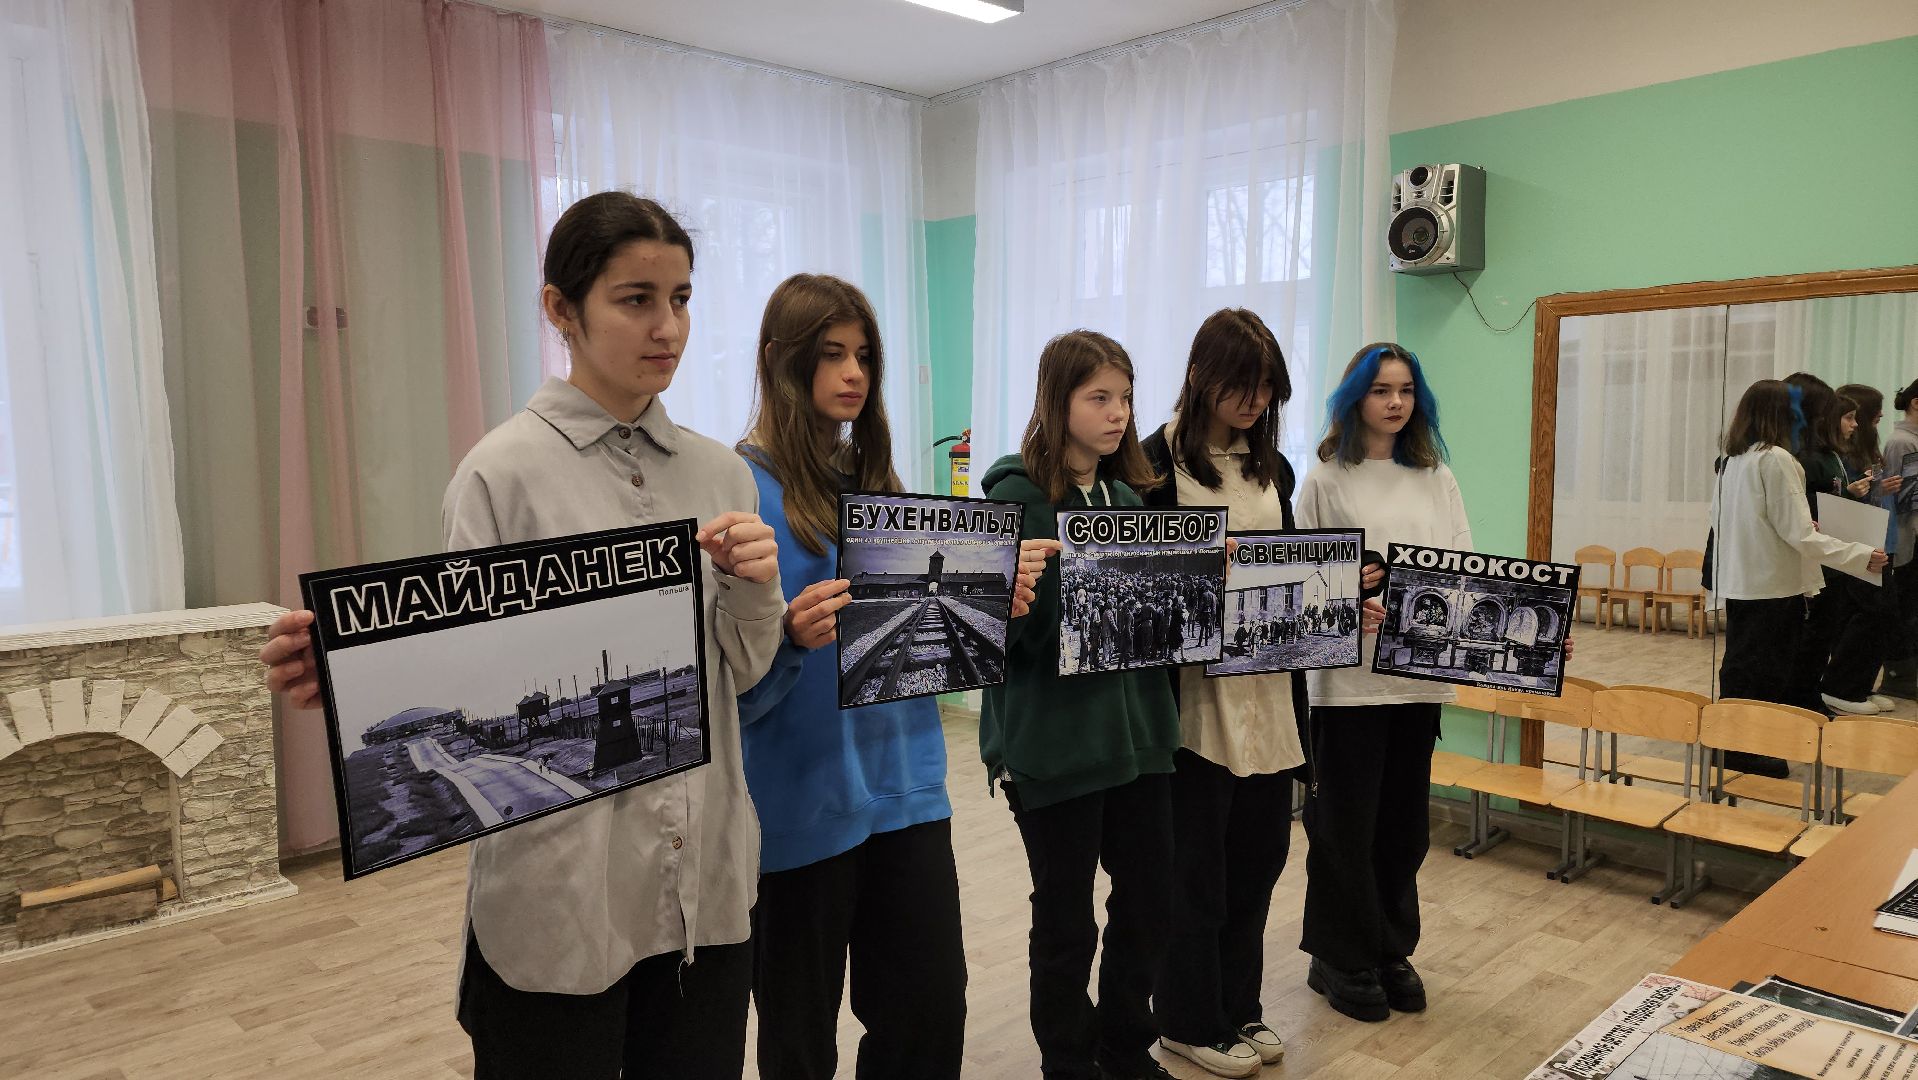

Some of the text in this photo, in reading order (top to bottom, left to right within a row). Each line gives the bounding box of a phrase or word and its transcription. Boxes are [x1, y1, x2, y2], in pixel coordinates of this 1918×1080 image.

[847, 503, 1017, 538] БУХЕНВАЛЬД
[1065, 513, 1220, 545] СОБИБОР
[1229, 540, 1358, 567] СВЕНЦИМ
[1392, 545, 1575, 585] ХОЛОКОСТ
[329, 535, 682, 637] МАЙДАНЕК
[658, 583, 690, 597] Польша
